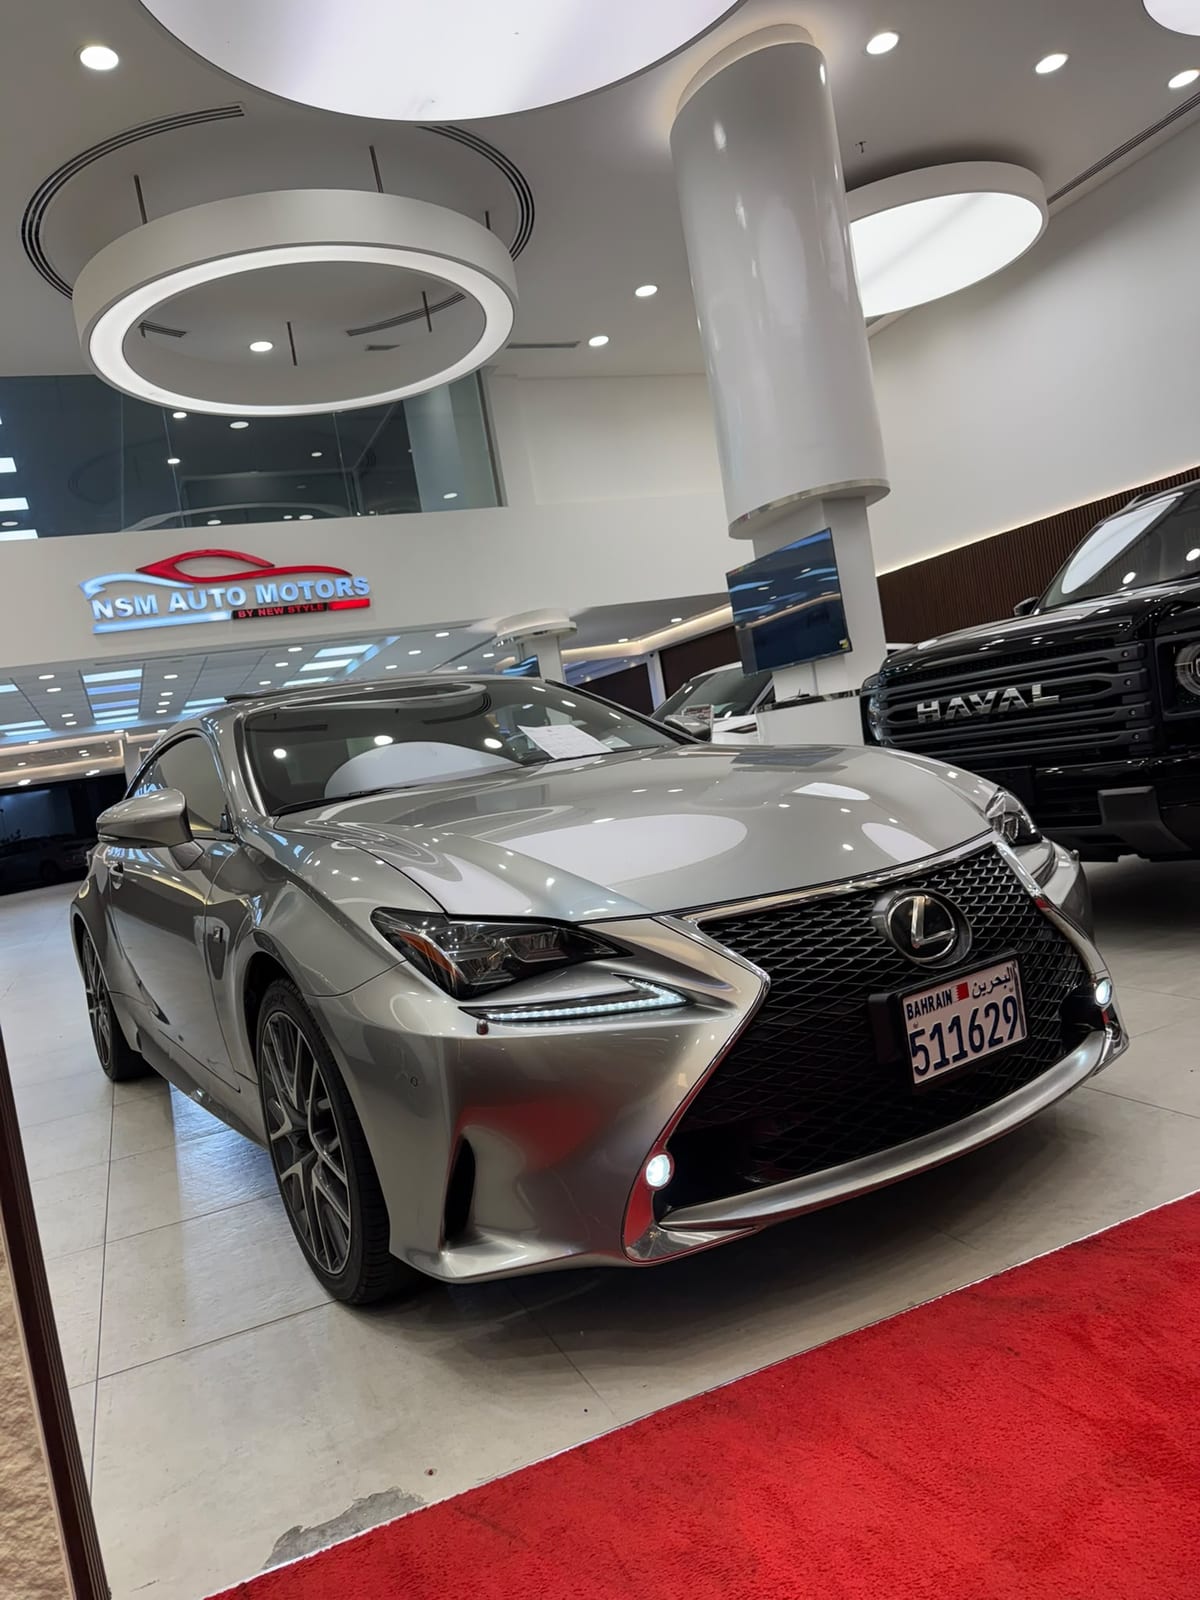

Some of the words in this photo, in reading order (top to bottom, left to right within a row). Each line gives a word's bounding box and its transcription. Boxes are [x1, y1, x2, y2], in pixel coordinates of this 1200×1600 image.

[92, 597, 159, 620] NSM
[168, 586, 246, 613] AUTO
[256, 577, 370, 605] MOTORS
[238, 608, 254, 619] BY
[258, 605, 284, 617] NEW
[288, 602, 325, 614] STYLE
[916, 683, 1060, 724] HAVAL
[972, 966, 1014, 999] البحرين
[906, 990, 953, 1020] BAHRAIN
[909, 995, 1018, 1076] 511629
